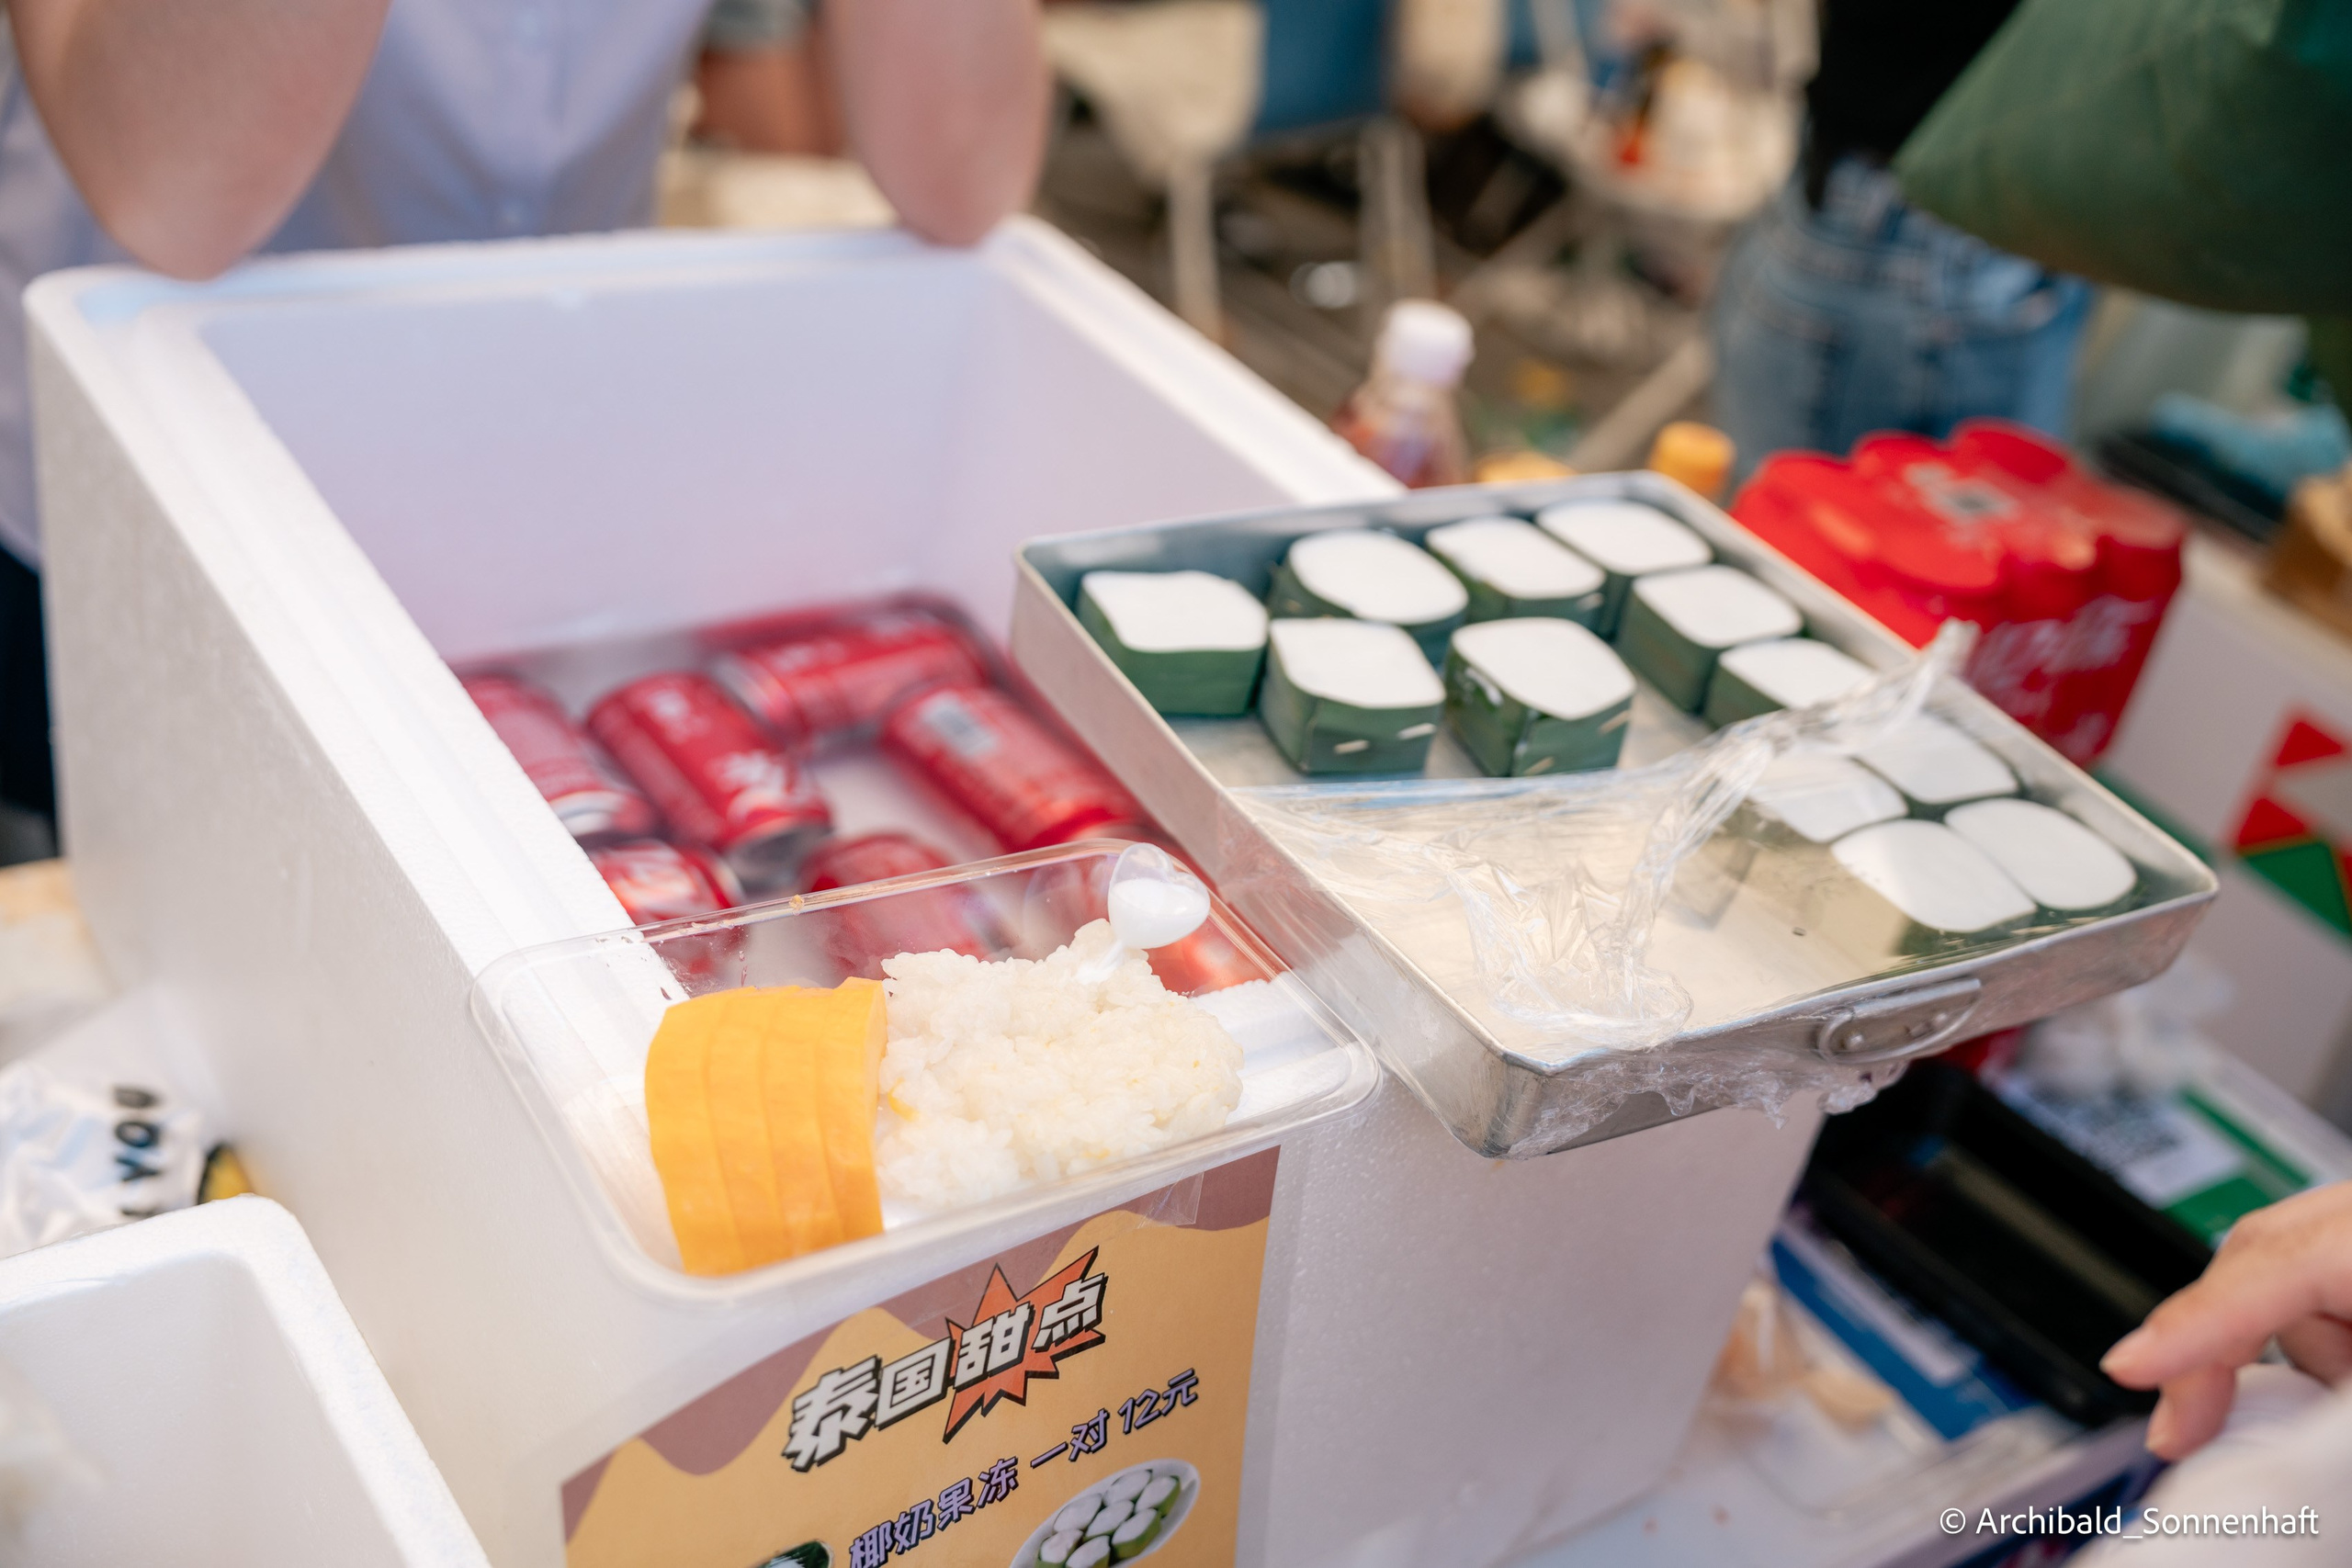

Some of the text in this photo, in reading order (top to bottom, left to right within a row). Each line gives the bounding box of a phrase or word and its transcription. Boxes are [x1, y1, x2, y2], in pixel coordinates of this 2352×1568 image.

[113, 1084, 161, 1182] YOU
[781, 1272, 1108, 1472] 泰国甜点
[849, 1368, 1199, 1568] 椰奶果冻 一对 12元
